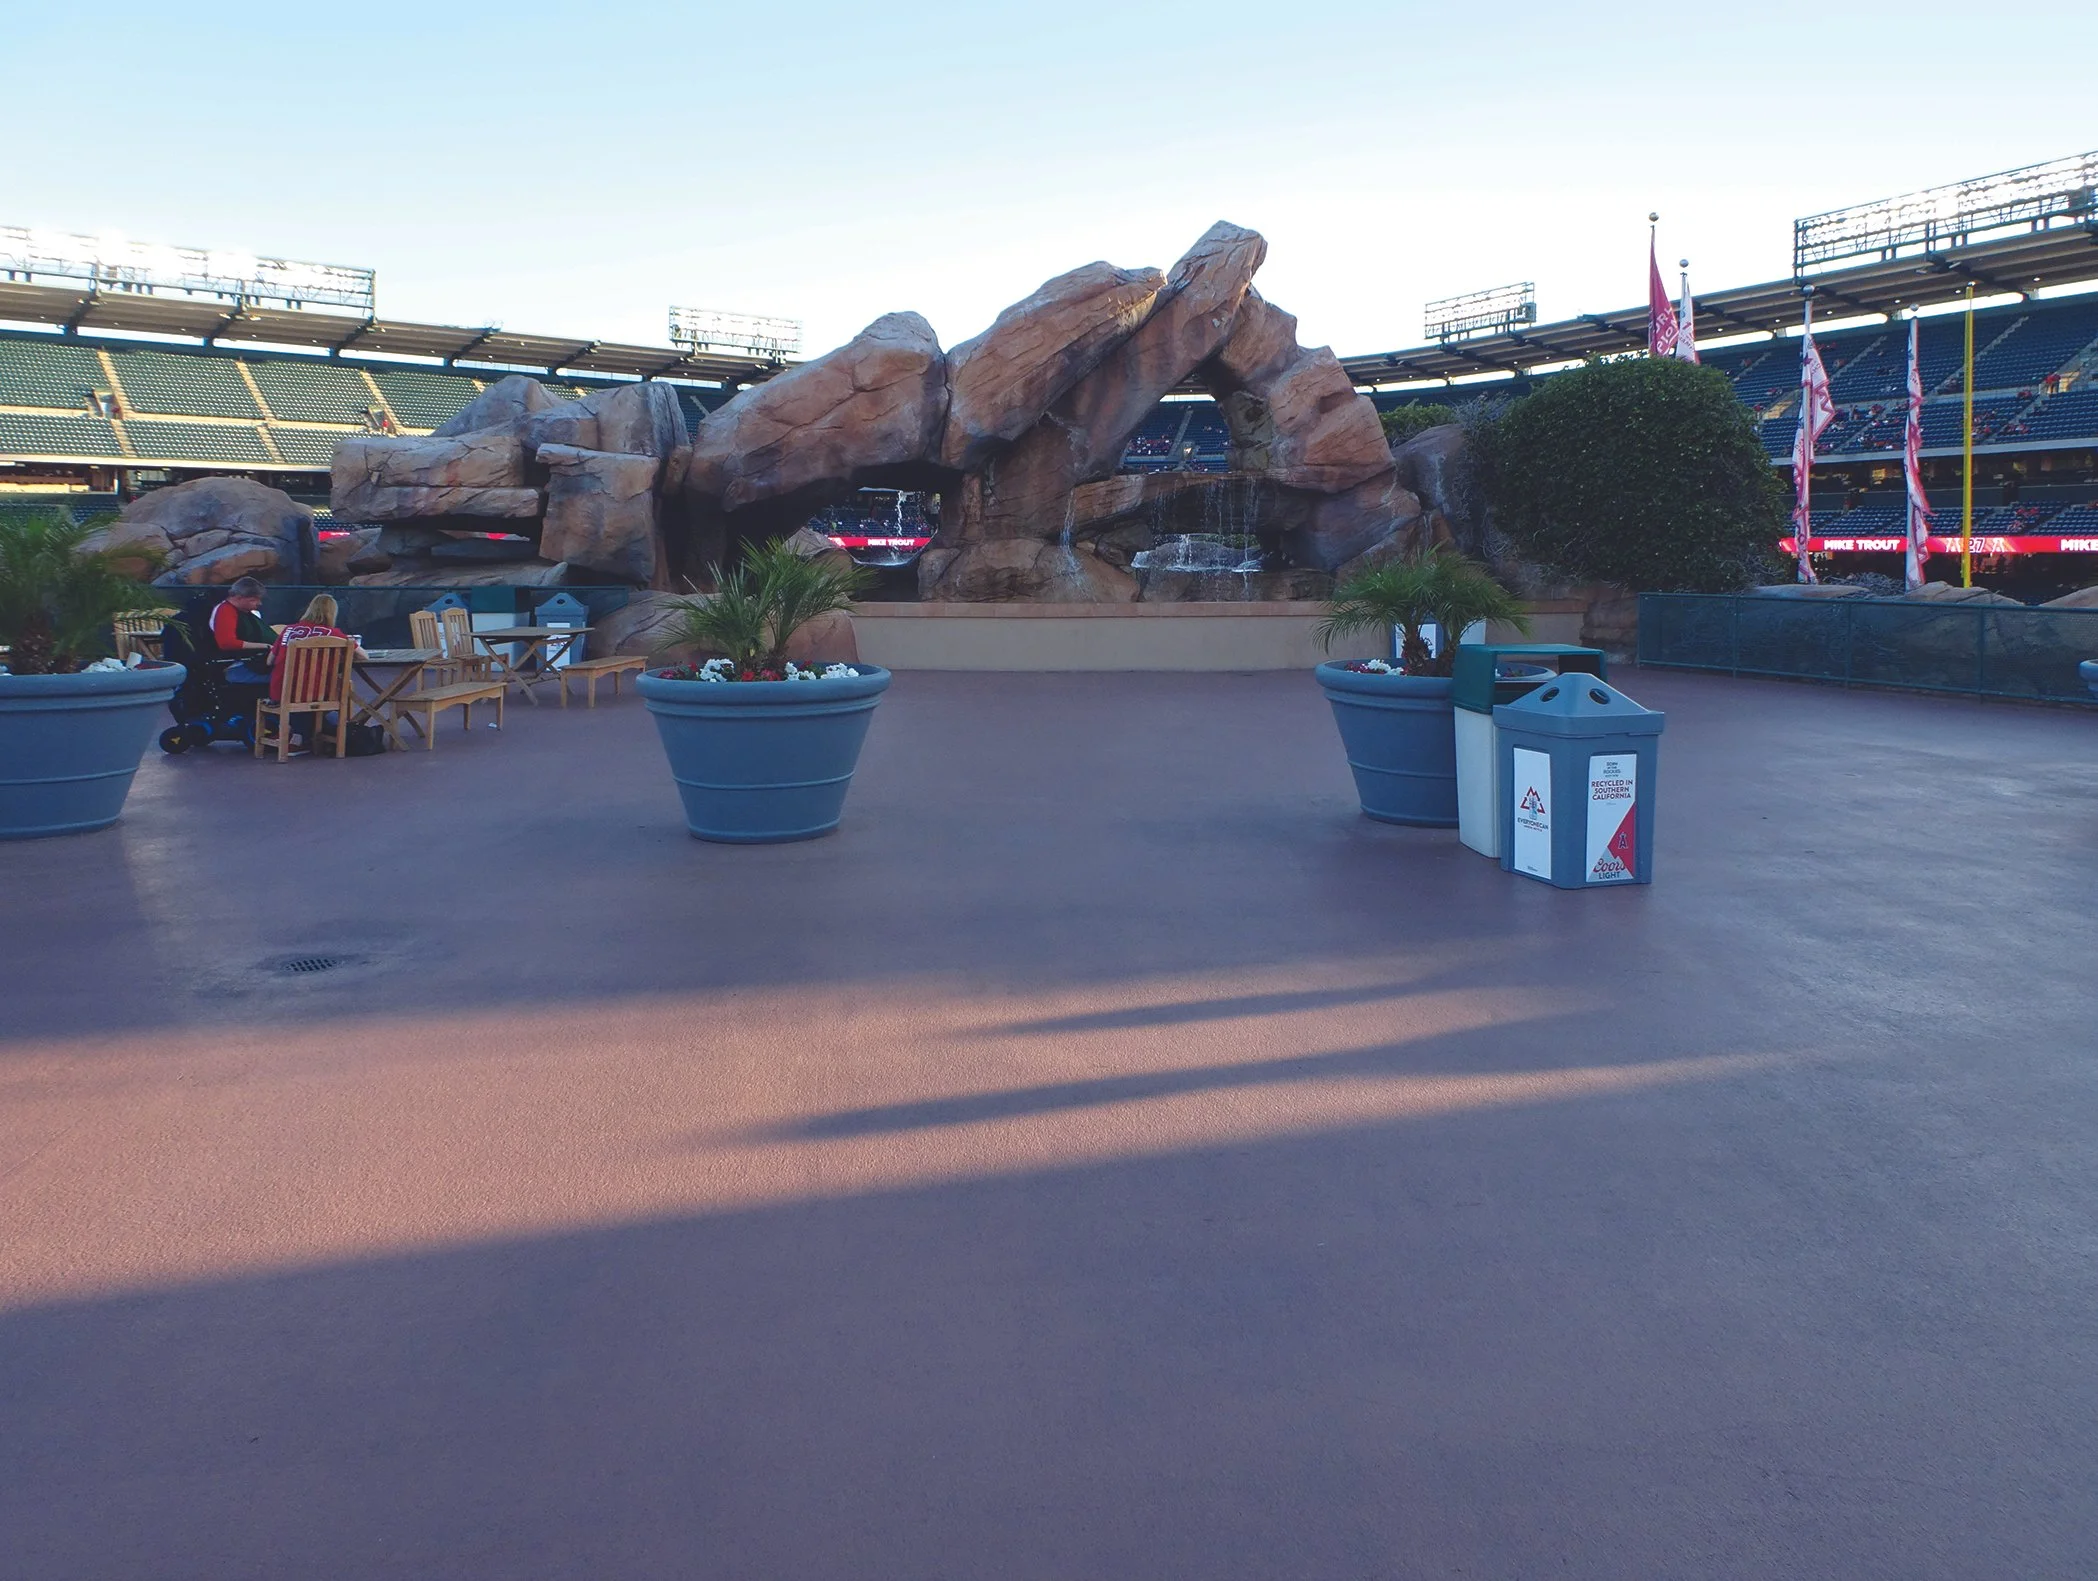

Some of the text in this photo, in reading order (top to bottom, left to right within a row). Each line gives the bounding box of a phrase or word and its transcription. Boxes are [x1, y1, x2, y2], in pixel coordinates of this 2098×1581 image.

[1824, 539, 1900, 551] MIKE TROUT
[1969, 538, 1985, 552] 27
[2061, 539, 2098, 551] MIKE
[1591, 780, 1624, 788] RECYCLED
[1595, 786, 1630, 794] SOUTHERN
[1592, 793, 1631, 801] CALIFORNIA
[1593, 858, 1625, 873] Coors
